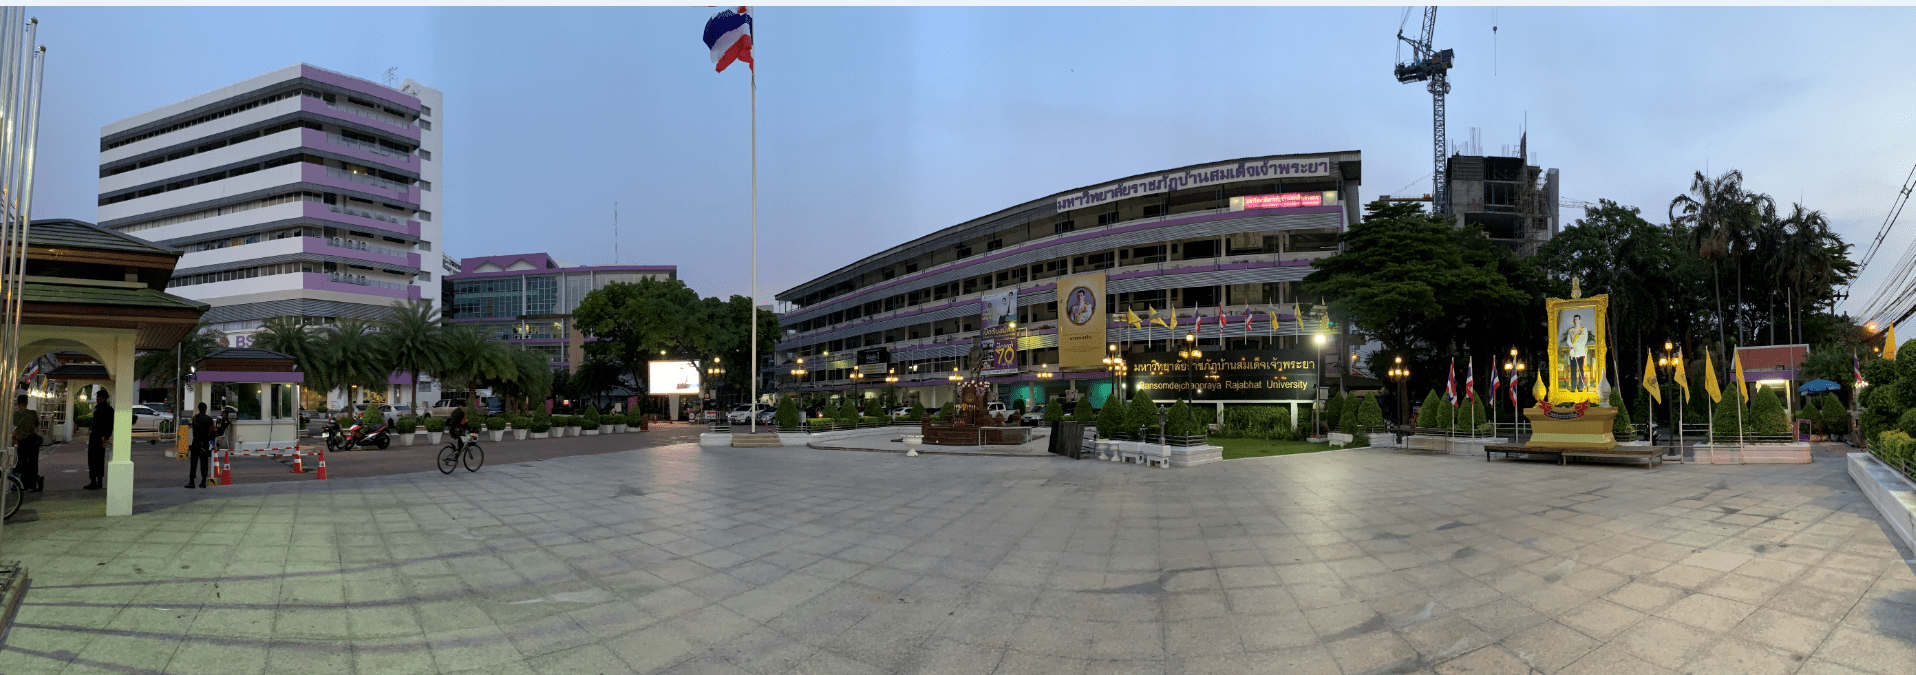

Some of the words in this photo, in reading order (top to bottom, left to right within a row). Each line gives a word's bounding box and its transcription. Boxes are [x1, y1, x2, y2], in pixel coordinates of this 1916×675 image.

[1057, 160, 1328, 210] มหาวิทยาลัยราชภัฏบ้านสมเด็จเจ้าพระยา
[995, 346, 1015, 364] 70
[1133, 357, 1315, 374] มหาวิทยาลัยาชภัฏบ้านสมเด็จเจ้าพระยา
[1225, 380, 1262, 391] Rajabhat
[1266, 380, 1308, 391] University
